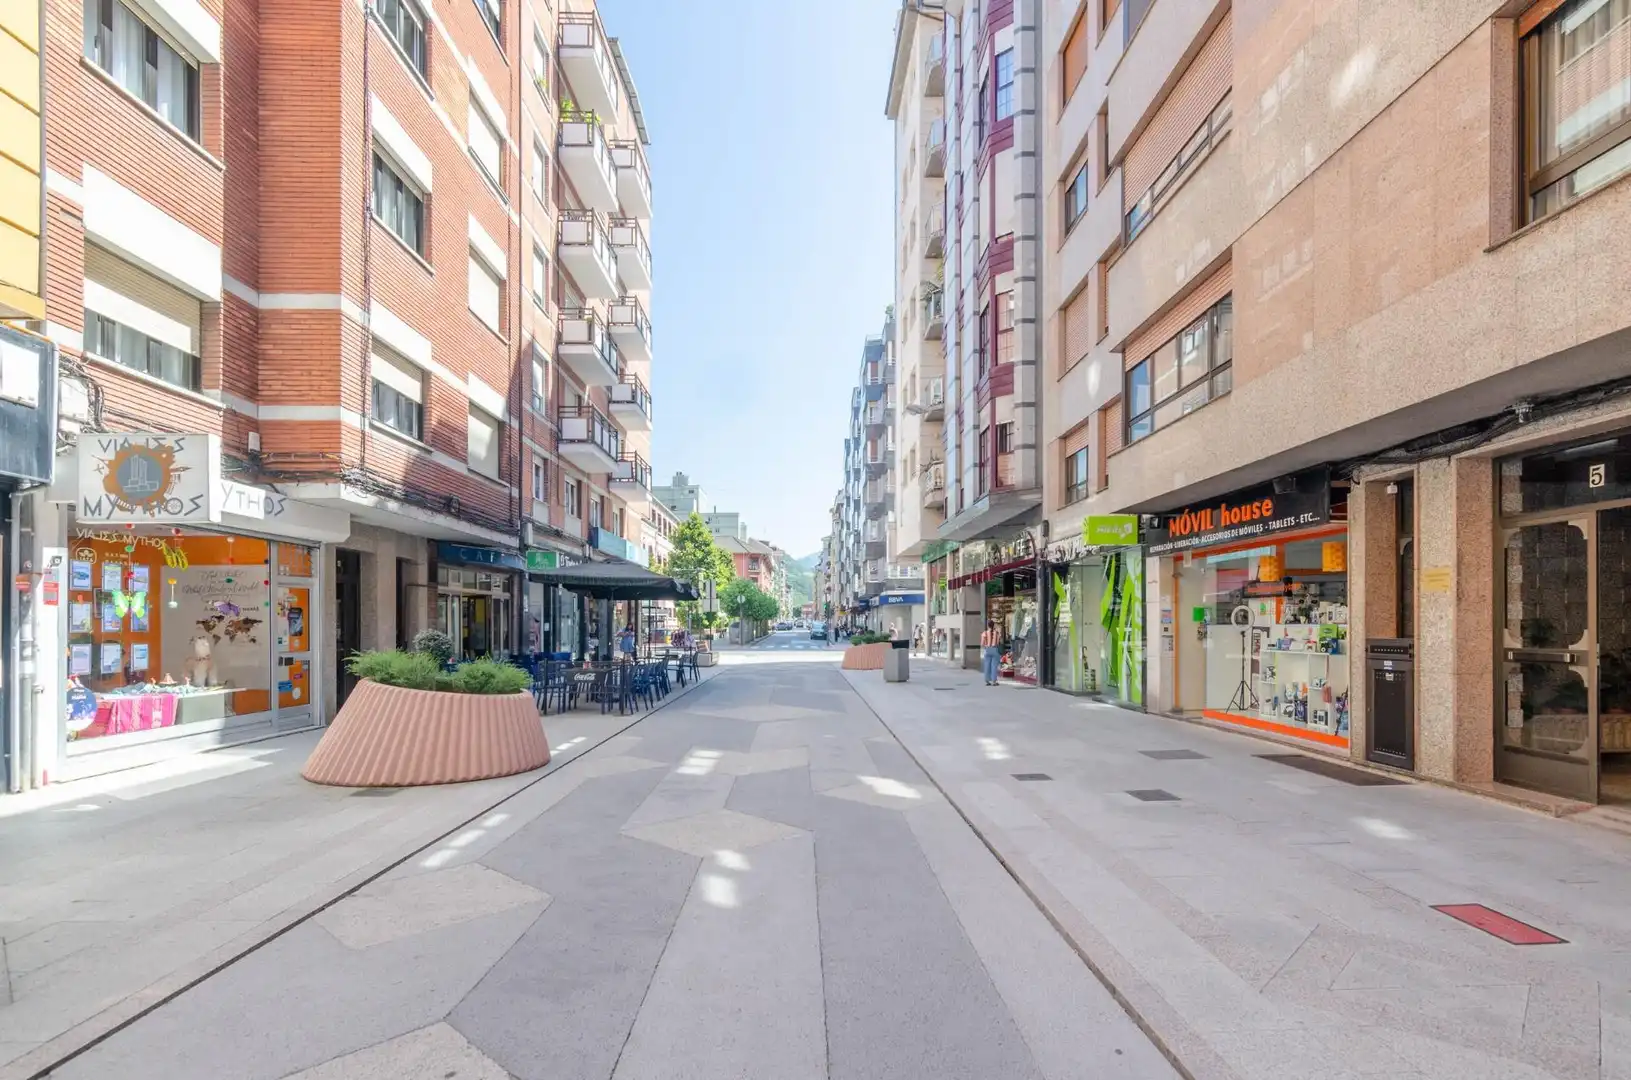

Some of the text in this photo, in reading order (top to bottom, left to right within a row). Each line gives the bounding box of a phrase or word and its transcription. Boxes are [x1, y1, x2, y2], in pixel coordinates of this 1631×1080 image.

[1591, 466, 1603, 486] 5
[83, 493, 204, 520] MYOS
[1168, 498, 1274, 539] MÓVIL house
[1231, 529, 1239, 538] DE
[1238, 523, 1263, 536] MÓVILES
[1268, 516, 1295, 530] TABLETS
